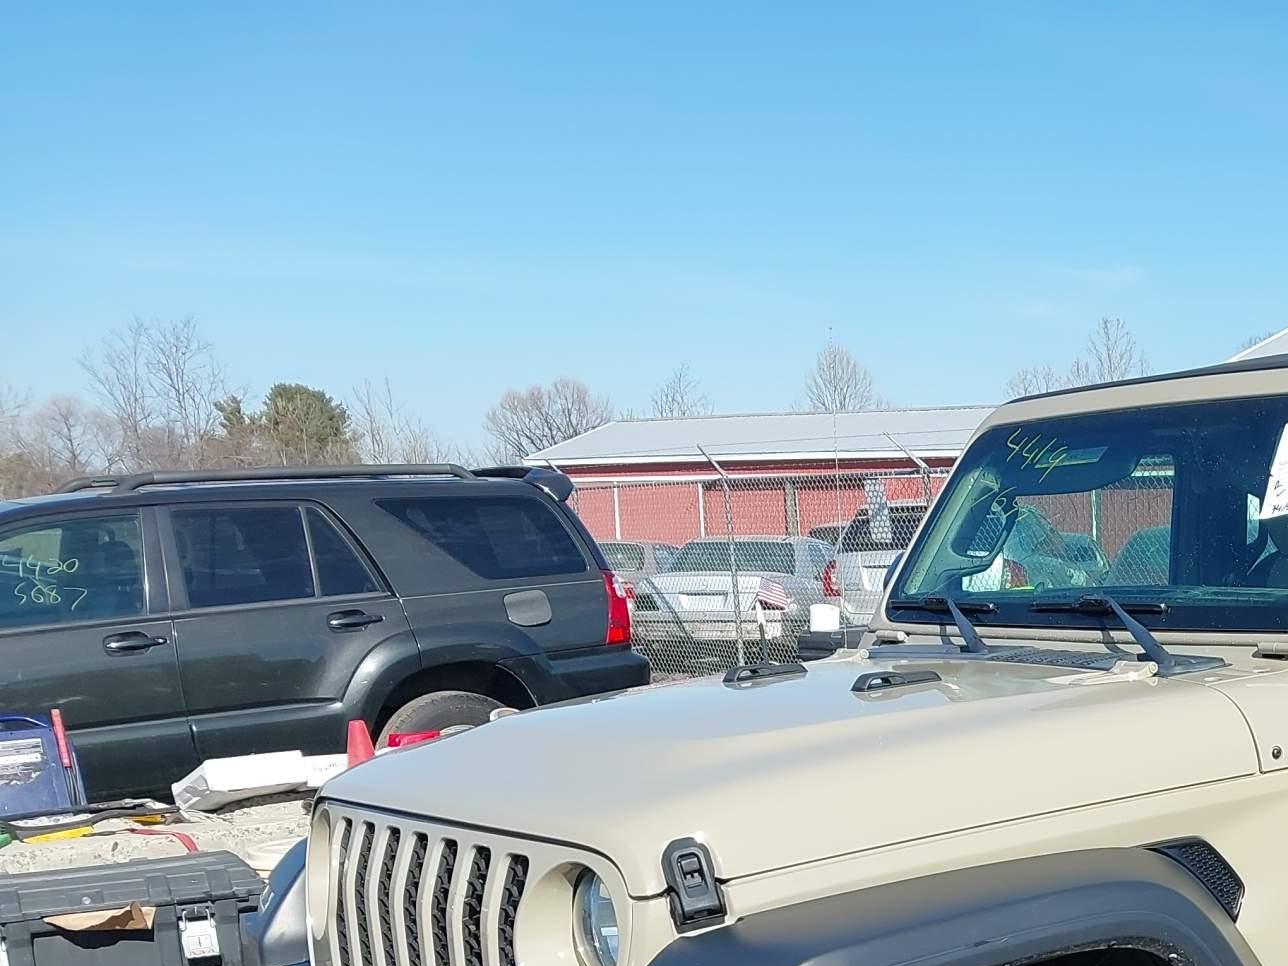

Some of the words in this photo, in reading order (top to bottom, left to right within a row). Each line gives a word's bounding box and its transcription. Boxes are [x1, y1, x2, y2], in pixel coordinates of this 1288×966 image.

[1006, 427, 1069, 484] 4419
[1, 554, 79, 580] 4420
[14, 581, 88, 612] 5687
